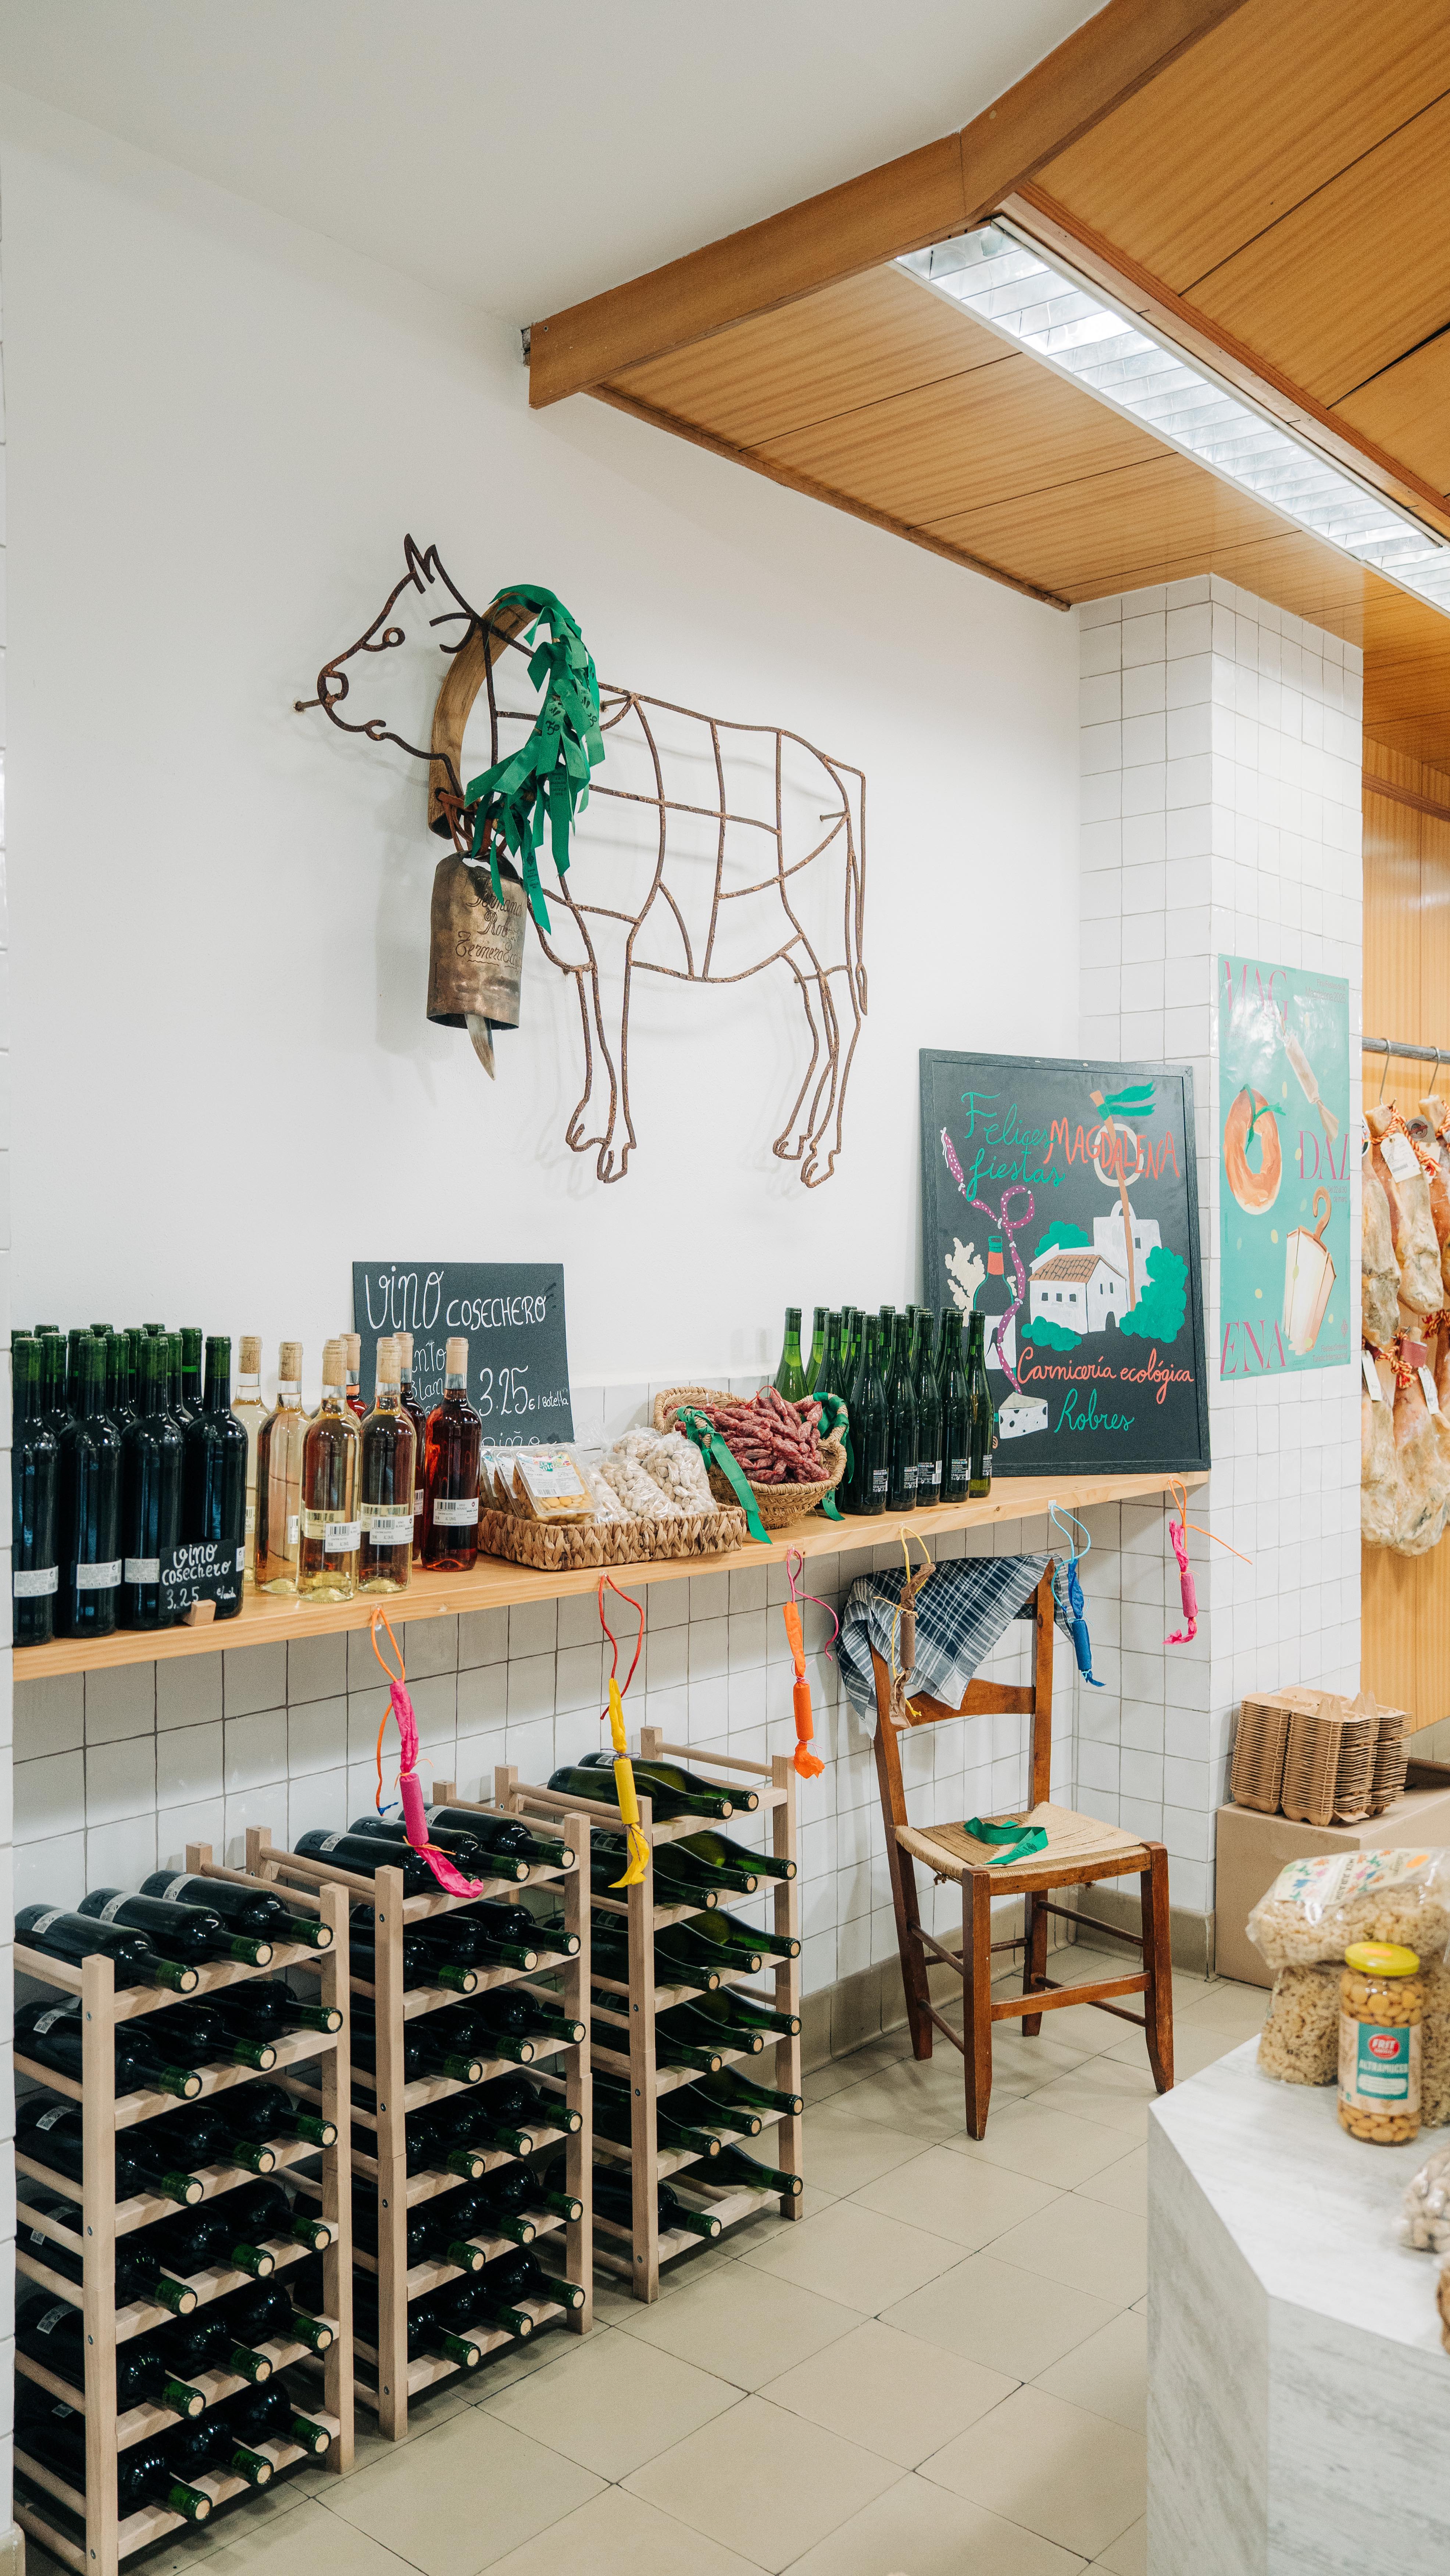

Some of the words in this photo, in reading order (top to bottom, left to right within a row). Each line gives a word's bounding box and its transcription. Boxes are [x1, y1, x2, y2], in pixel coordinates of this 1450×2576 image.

[961, 1092, 1056, 1148] Felices
[1043, 1117, 1180, 1180] MAGDALENA
[1298, 1131, 1350, 1180] DAL
[966, 1149, 1066, 1202] fiestas
[446, 1296, 547, 1331] COSECHERO
[1220, 1318, 1287, 1374] ENA
[1017, 1346, 1117, 1384] Carnicería
[1120, 1349, 1195, 1404] ecológica
[1053, 1387, 1135, 1434] Robres
[162, 1560, 232, 1586] cosechero
[173, 1544, 218, 1569] vino
